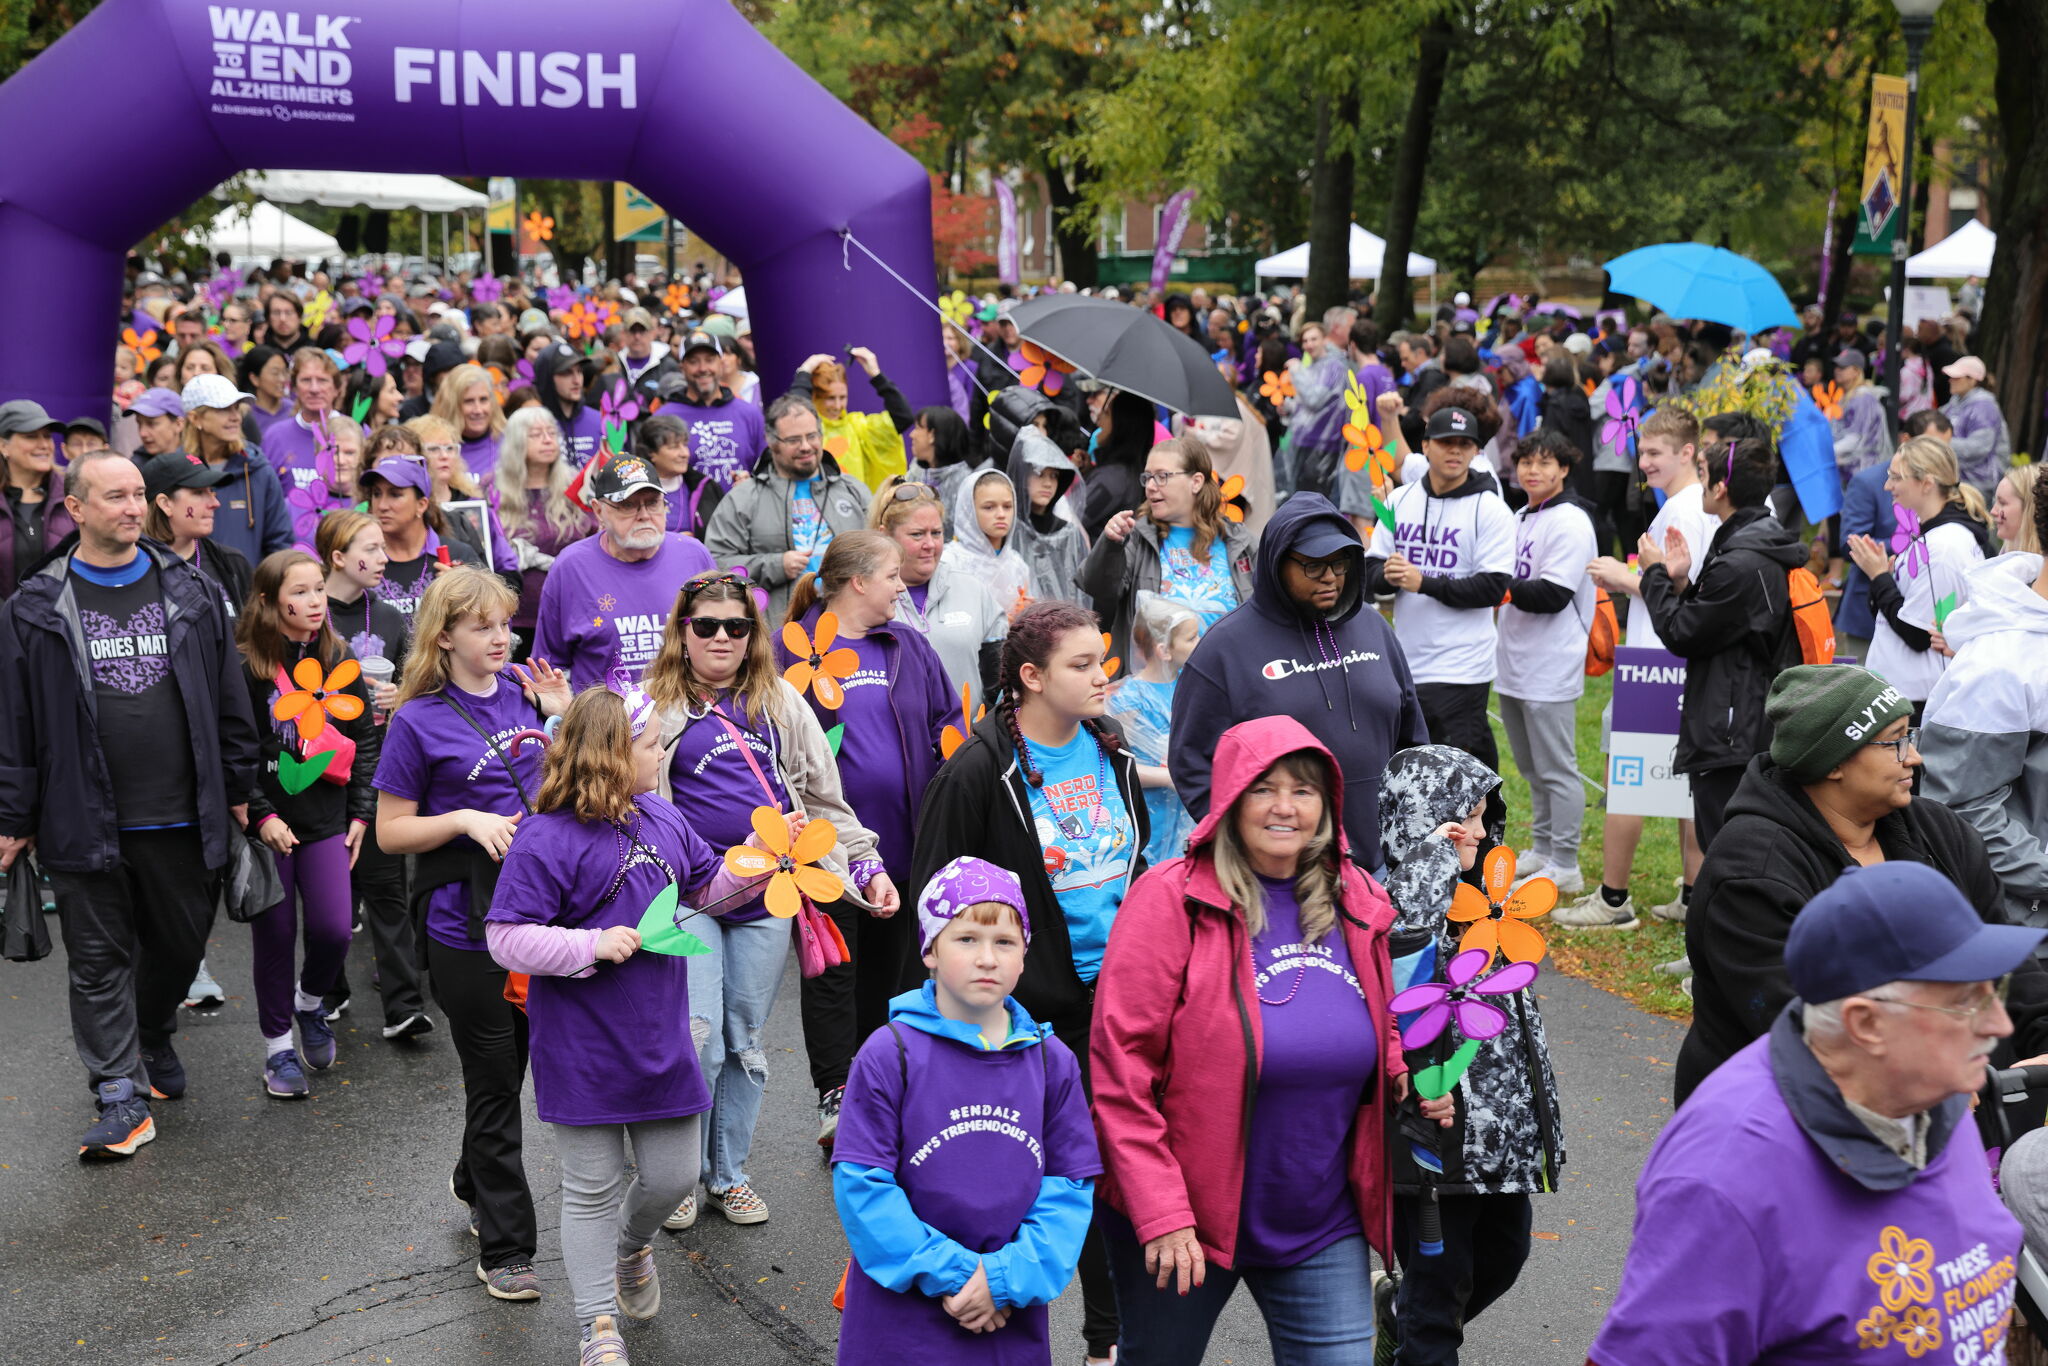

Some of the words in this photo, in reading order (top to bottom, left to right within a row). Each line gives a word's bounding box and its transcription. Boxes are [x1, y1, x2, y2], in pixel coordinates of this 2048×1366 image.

[208, 5, 352, 49] WALK
[217, 53, 243, 68] TO
[251, 44, 352, 86] END
[394, 46, 637, 109] FINISH
[210, 79, 353, 106] ALZHEIMER'S
[211, 103, 273, 117] ALZHEIMER'S
[292, 109, 355, 122] ASSOCIATION
[1395, 522, 1461, 547] WALK
[1408, 546, 1457, 568] END
[614, 613, 672, 635] WAL
[90, 636, 134, 660] ORIES
[137, 635, 168, 656] MAT
[637, 632, 665, 651] EN
[1262, 650, 1380, 680] Champion
[467, 757, 488, 781] TIM'S
[694, 753, 713, 775] TIM'S
[1043, 774, 1097, 800] NERD
[1049, 791, 1102, 815] HERD
[949, 1104, 1021, 1123] #ENDALZ
[909, 1136, 941, 1167] TIM'S
[939, 1119, 1028, 1142] TREMENDOUS
[1935, 1242, 1992, 1288] THESE
[1948, 1299, 1999, 1343] HAVE
[1953, 1335, 1982, 1366] OF
